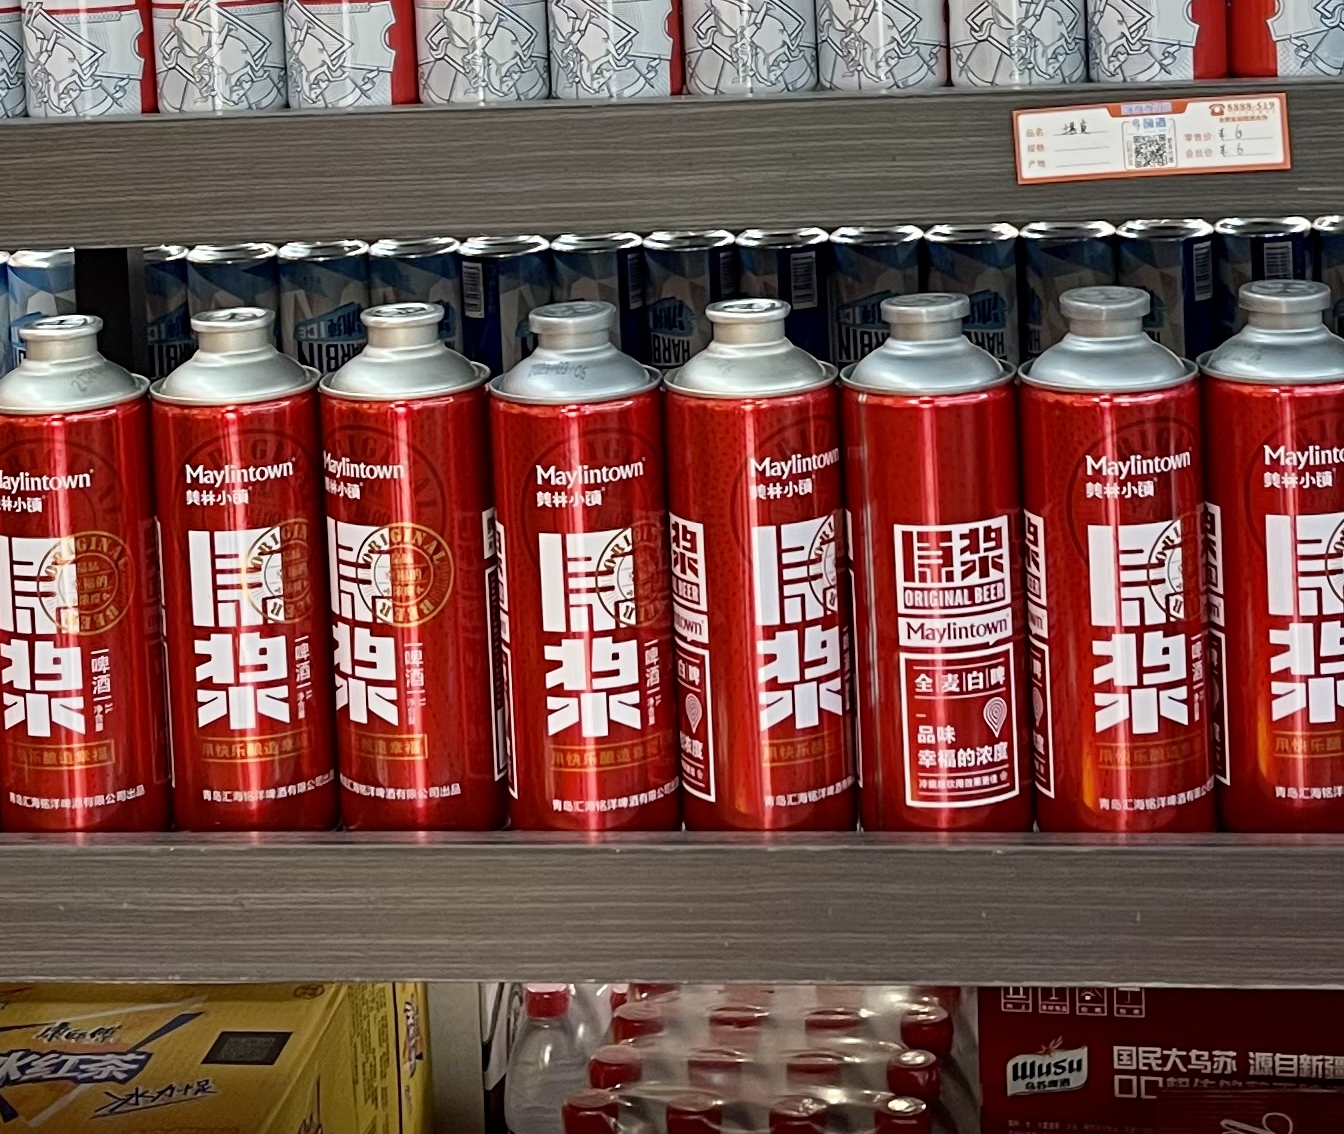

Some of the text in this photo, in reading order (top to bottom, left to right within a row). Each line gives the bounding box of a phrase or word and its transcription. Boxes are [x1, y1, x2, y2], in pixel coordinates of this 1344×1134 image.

[185, 459, 293, 488] Maylintown
[536, 459, 644, 488] Maylintown
[1085, 450, 1191, 477] Maylintown
[902, 527, 1004, 584] 原浆
[905, 584, 1005, 607] ORIGINAL BEER
[906, 617, 1008, 644] Maylintown
[918, 725, 955, 744] 品味
[918, 742, 1008, 768] 幸福的浓度
[1114, 1046, 1237, 1074] 国民大乌苏
